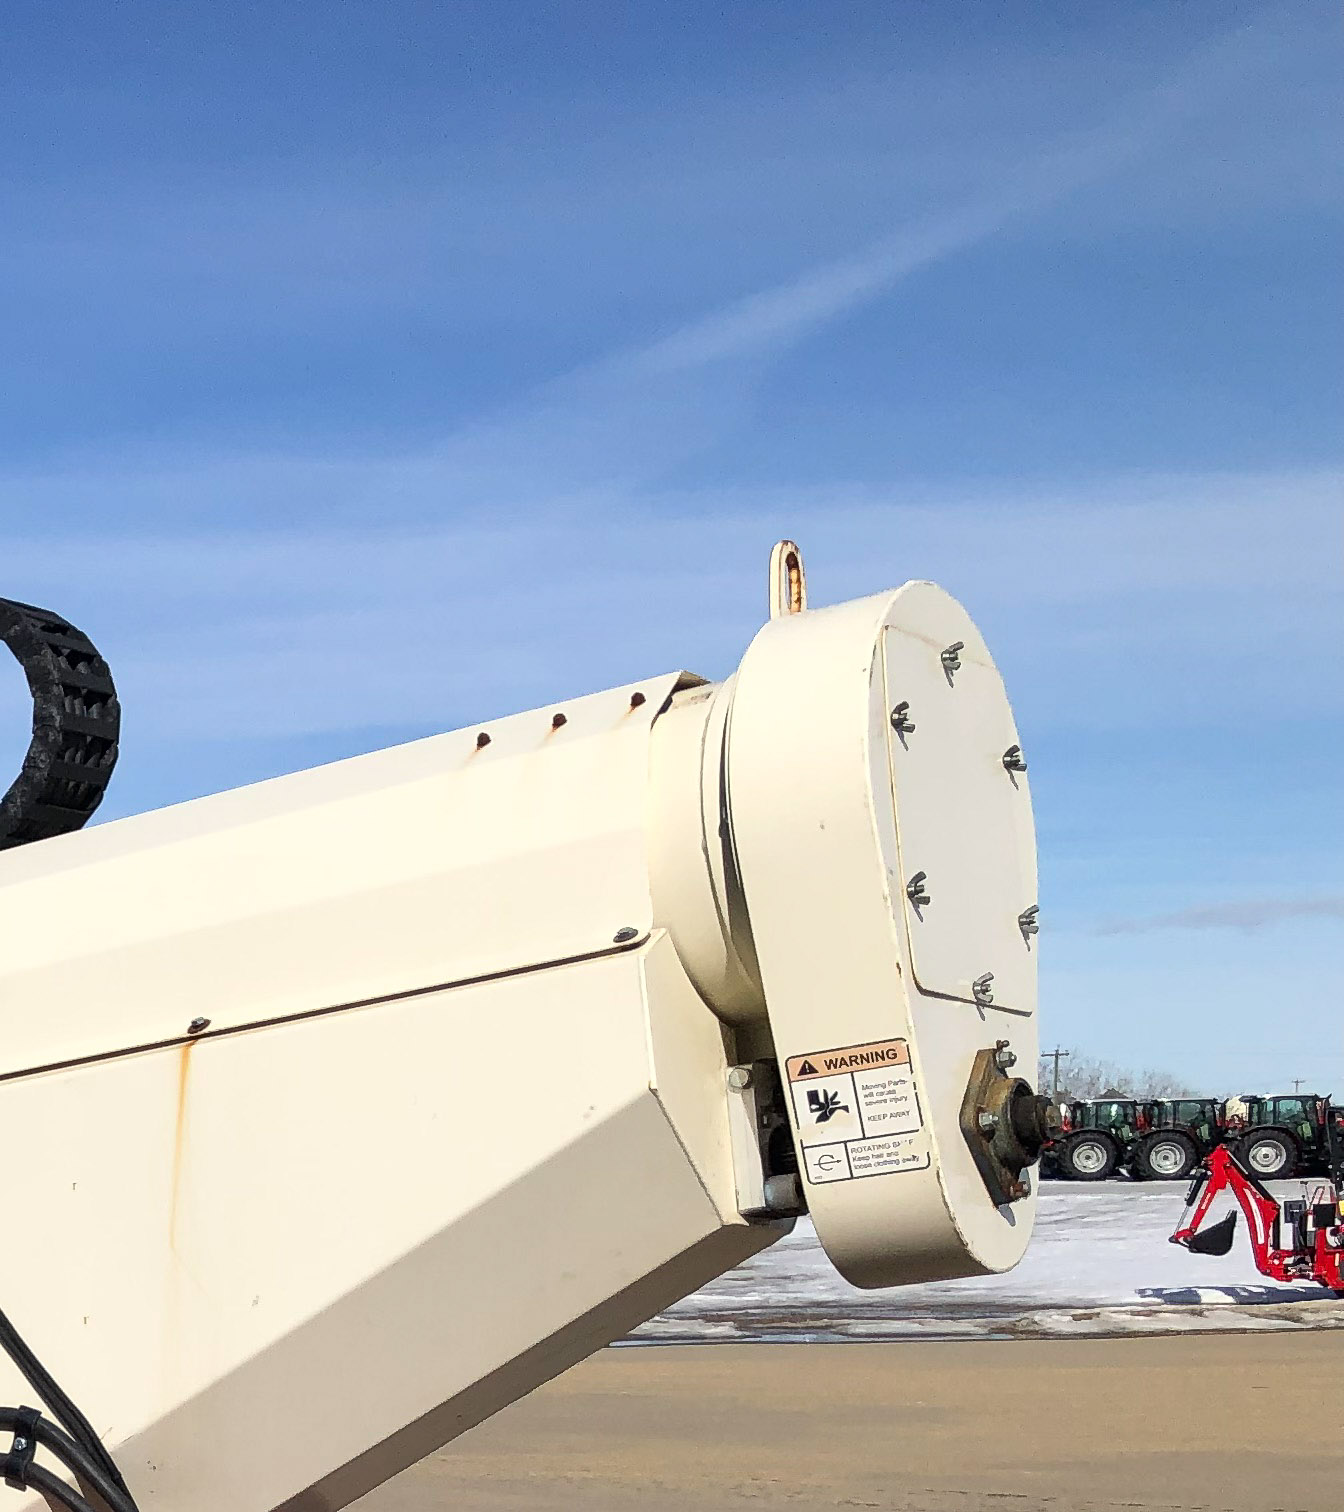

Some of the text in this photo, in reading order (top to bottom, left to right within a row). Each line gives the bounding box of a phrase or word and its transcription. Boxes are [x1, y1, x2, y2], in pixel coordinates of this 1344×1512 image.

[824, 1048, 898, 1070] WARNING
[867, 1110, 910, 1121] KEEP AWAY
[850, 1143, 891, 1154] ROTATING
